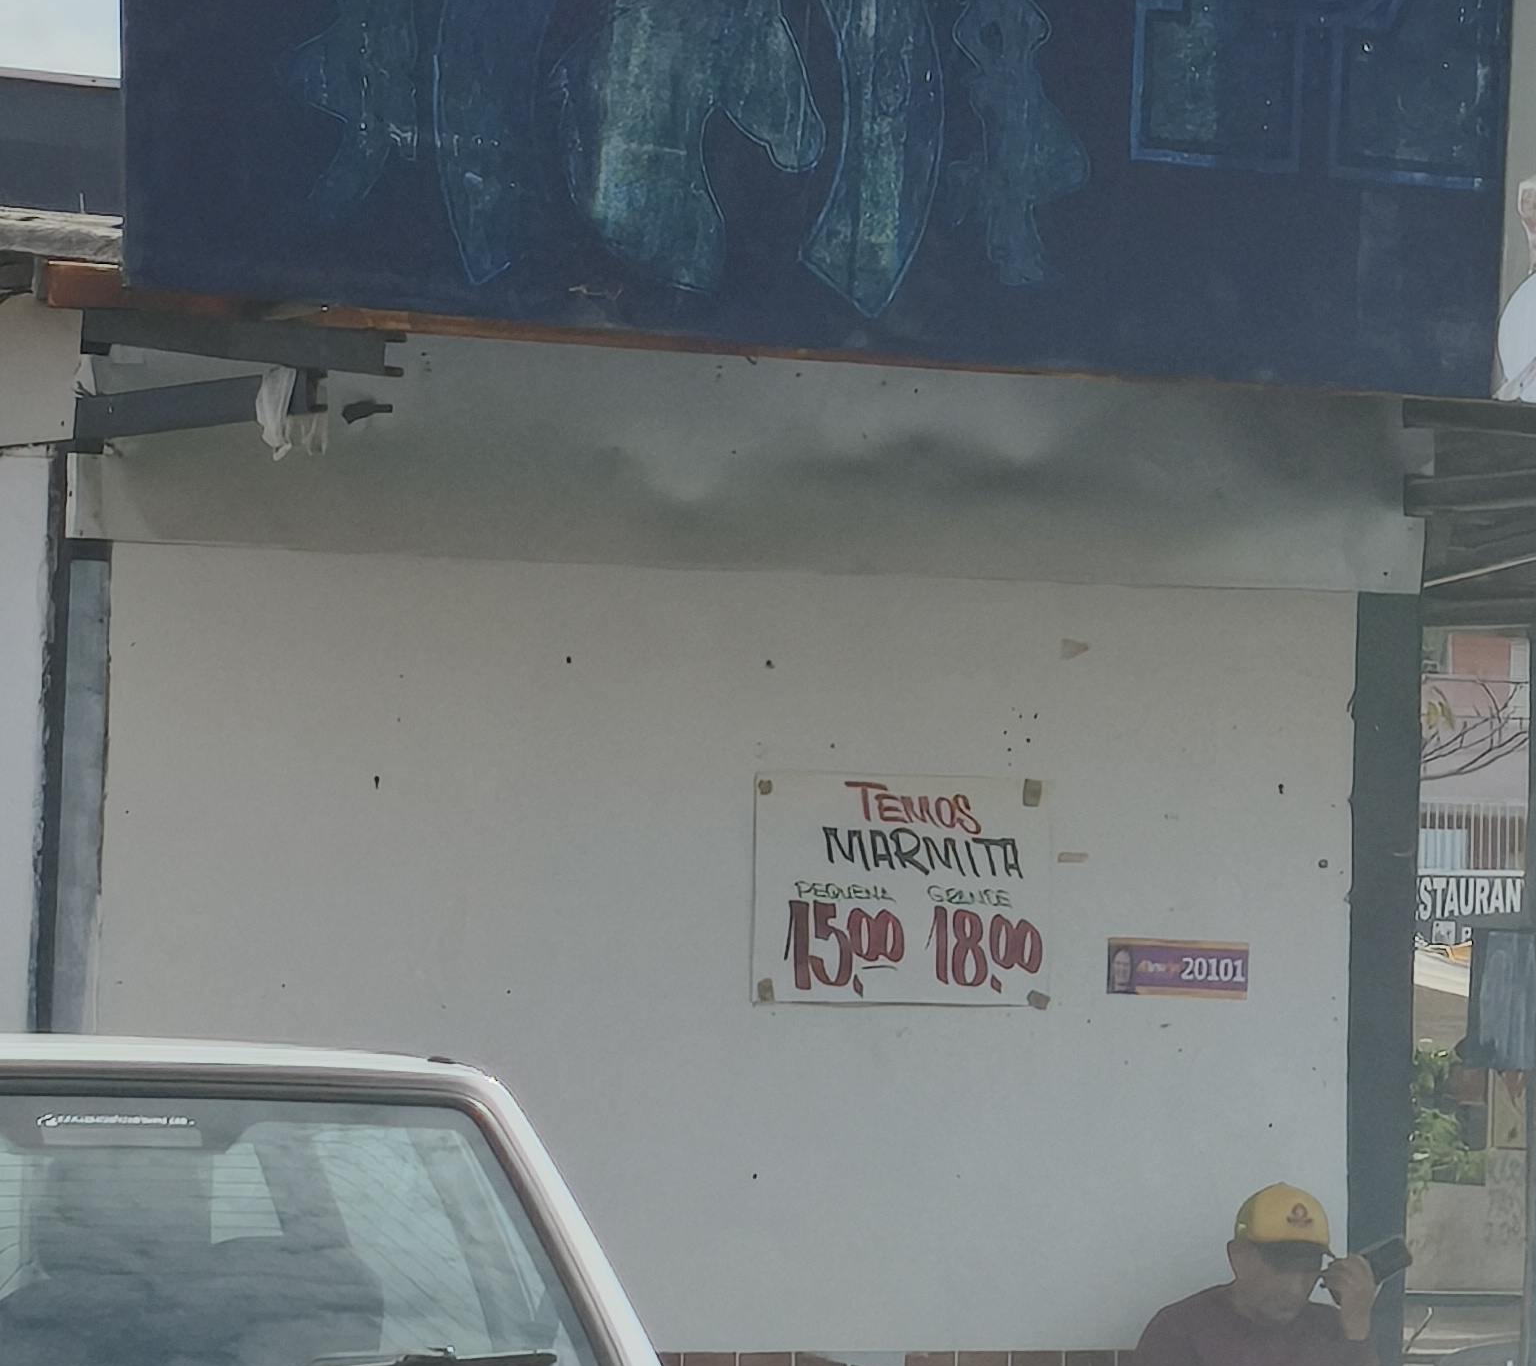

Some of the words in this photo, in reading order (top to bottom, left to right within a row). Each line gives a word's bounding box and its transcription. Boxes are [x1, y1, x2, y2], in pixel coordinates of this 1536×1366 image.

[822, 826, 1024, 879] MARMITA
[1415, 877, 1523, 921] STAURAN
[1180, 957, 1246, 982] 20101
